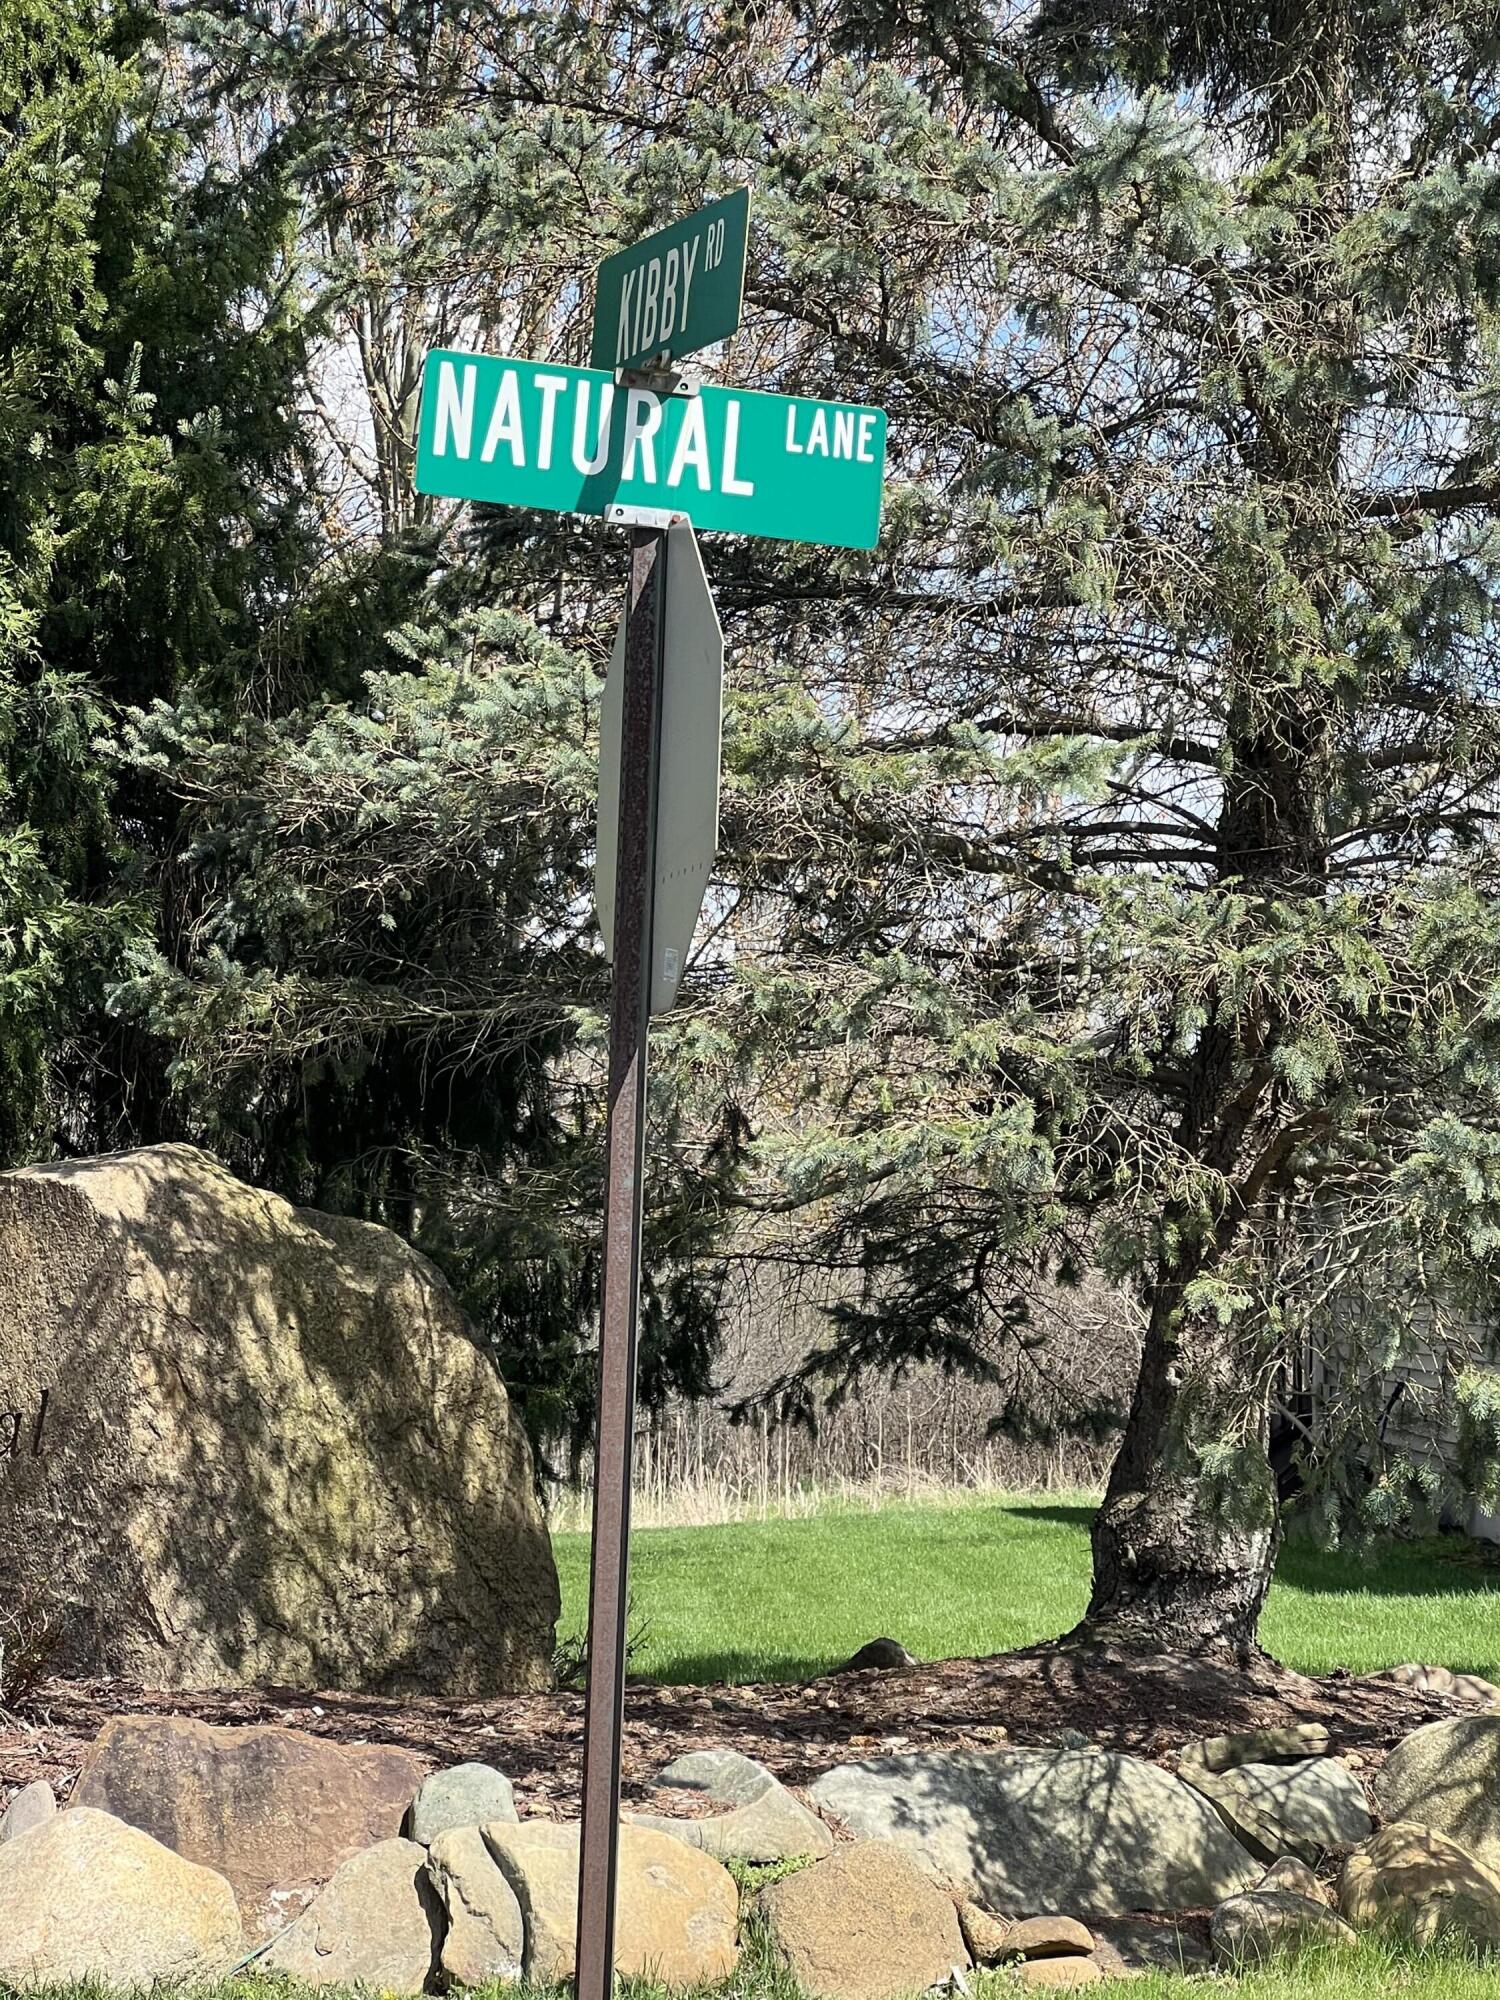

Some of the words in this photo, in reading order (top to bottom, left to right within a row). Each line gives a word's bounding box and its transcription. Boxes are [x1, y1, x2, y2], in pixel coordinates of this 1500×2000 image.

[616, 234, 700, 363] KIBBY
[704, 218, 725, 272] RD
[432, 361, 754, 496] NATURAL
[785, 404, 876, 462] LANE
